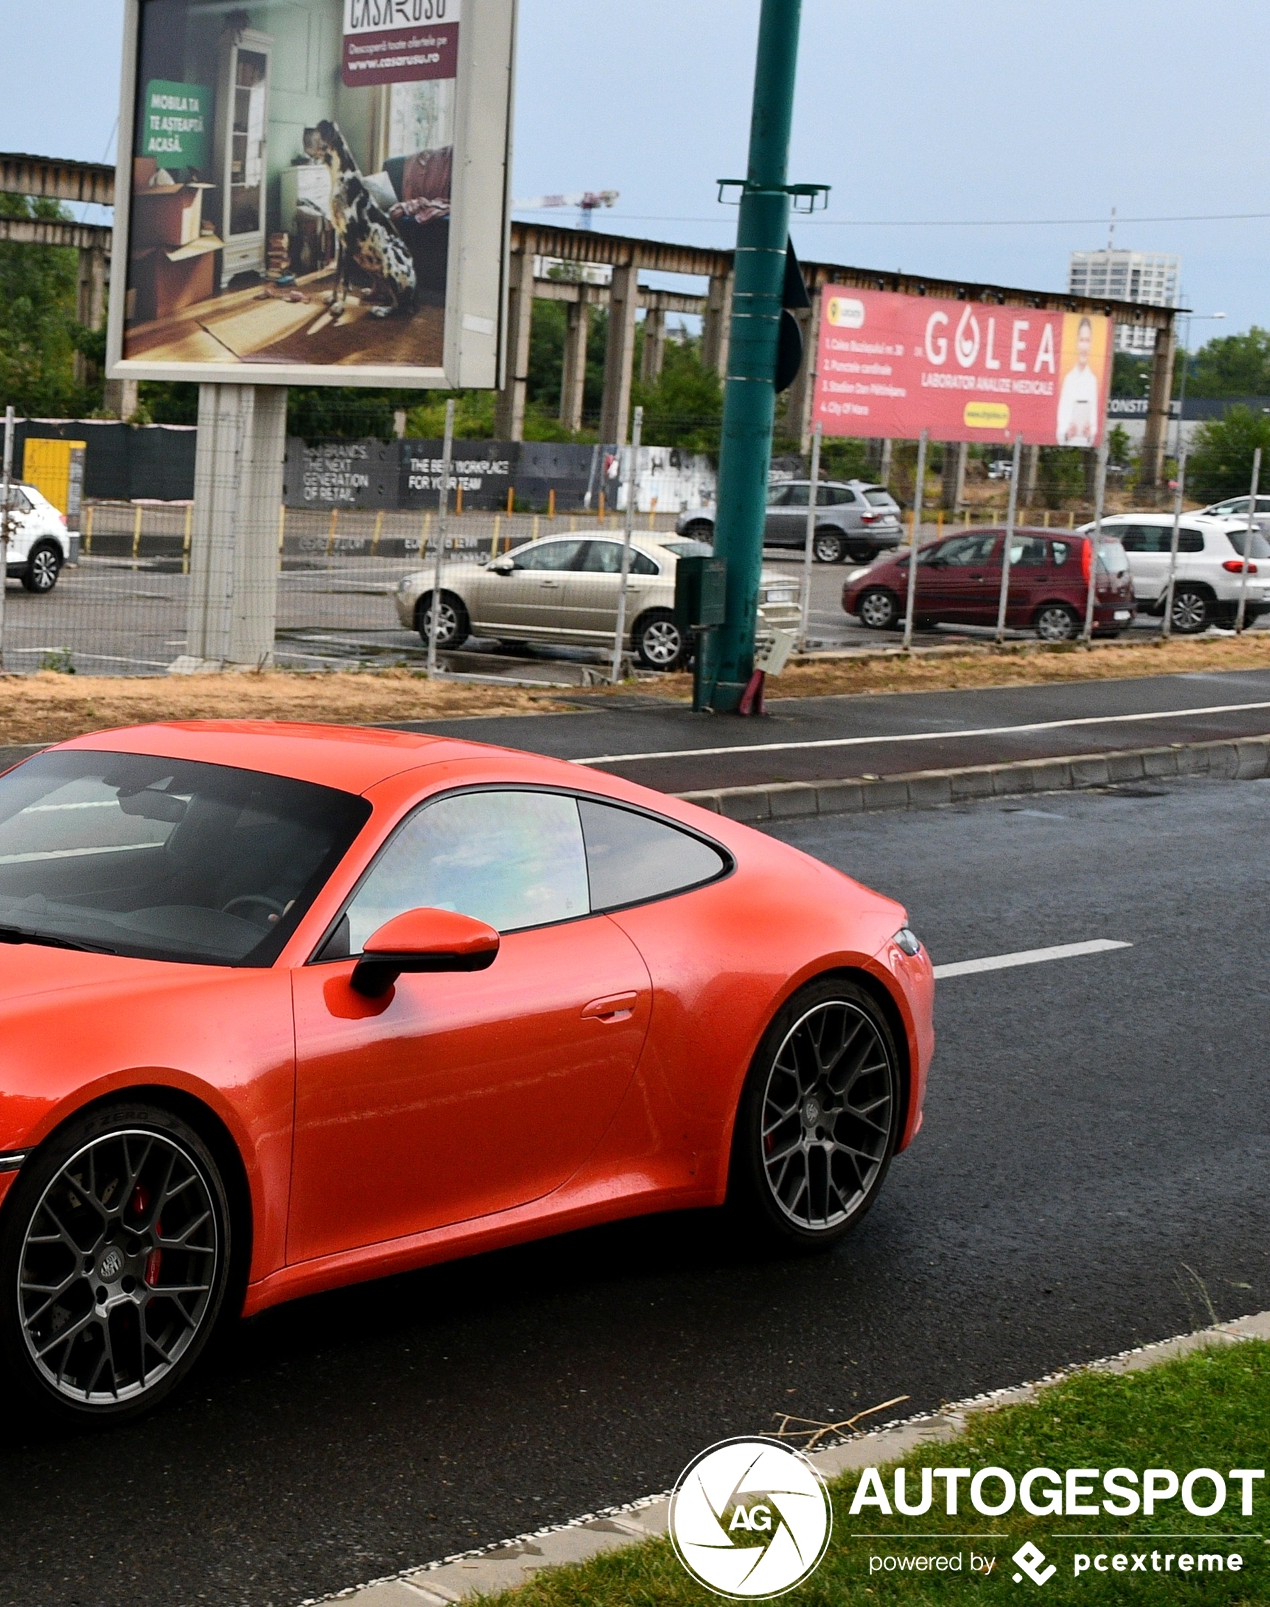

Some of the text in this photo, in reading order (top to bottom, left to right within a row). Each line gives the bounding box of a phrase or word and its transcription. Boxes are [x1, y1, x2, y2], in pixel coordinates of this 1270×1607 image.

[436, 37, 447, 48] pe
[150, 93, 200, 113] MOBILA TA
[150, 115, 160, 130] TE
[924, 303, 1056, 375] GOLEA
[921, 372, 1054, 396] LABORATOR ANALIZE MEDICALE
[409, 458, 430, 473] THE
[408, 475, 430, 490] FOR
